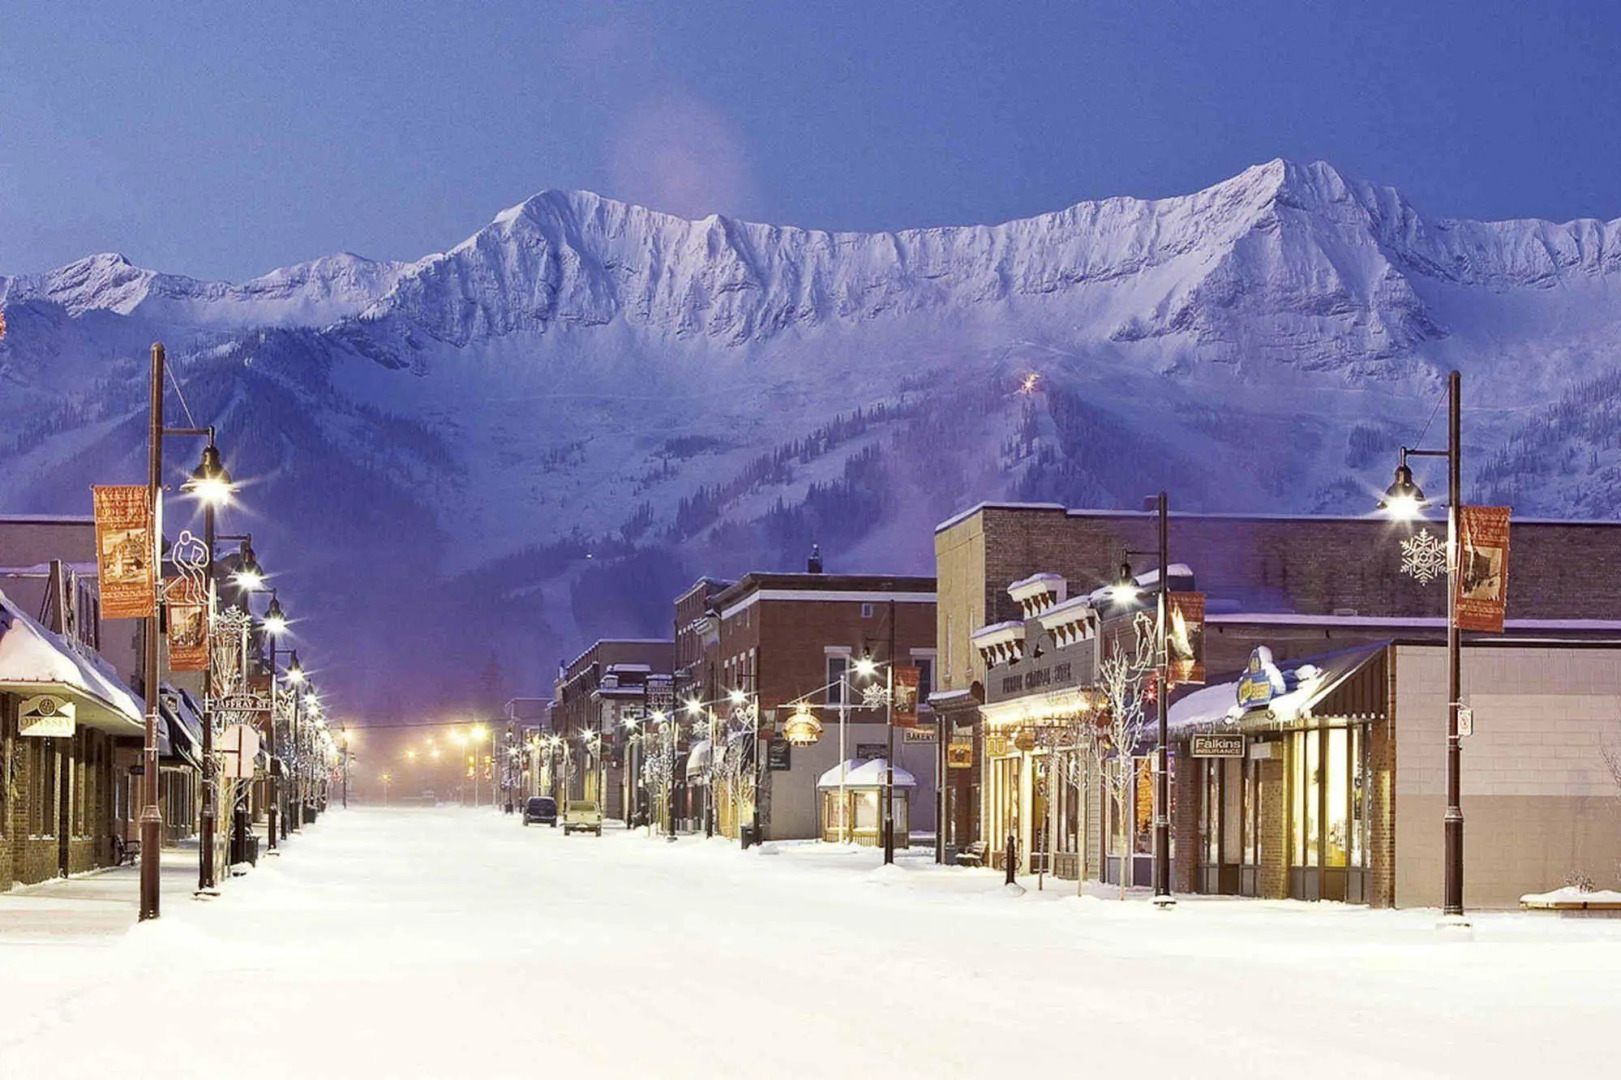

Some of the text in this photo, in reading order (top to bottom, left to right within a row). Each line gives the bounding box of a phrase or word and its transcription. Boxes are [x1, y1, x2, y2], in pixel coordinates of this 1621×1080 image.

[215, 700, 267, 709] JAFFRAY ST
[20, 717, 71, 729] ODYSSEY
[905, 731, 936, 741] BAKERY
[1195, 738, 1241, 748] Falkins
